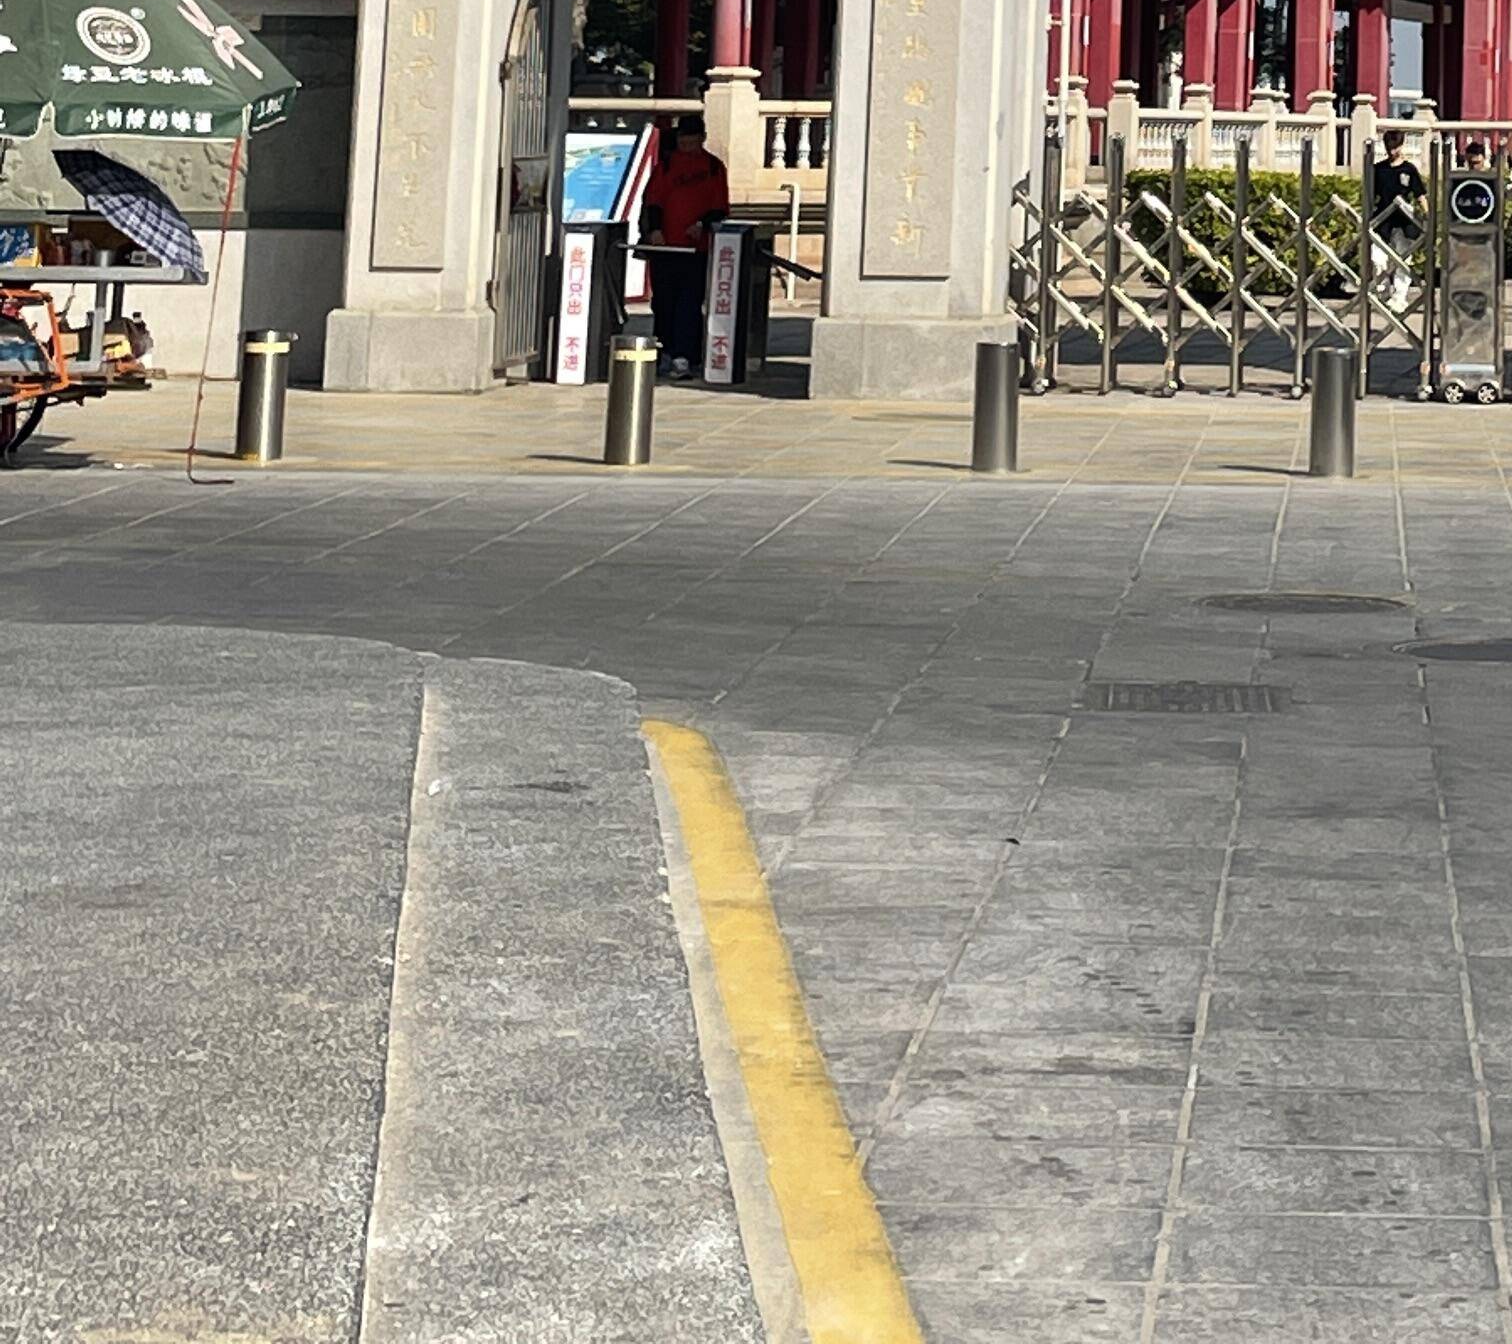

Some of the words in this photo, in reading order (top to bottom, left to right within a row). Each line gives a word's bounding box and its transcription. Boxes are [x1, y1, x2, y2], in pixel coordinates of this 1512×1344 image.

[567, 246, 586, 316] 此门只出
[715, 246, 735, 316] 此门只出
